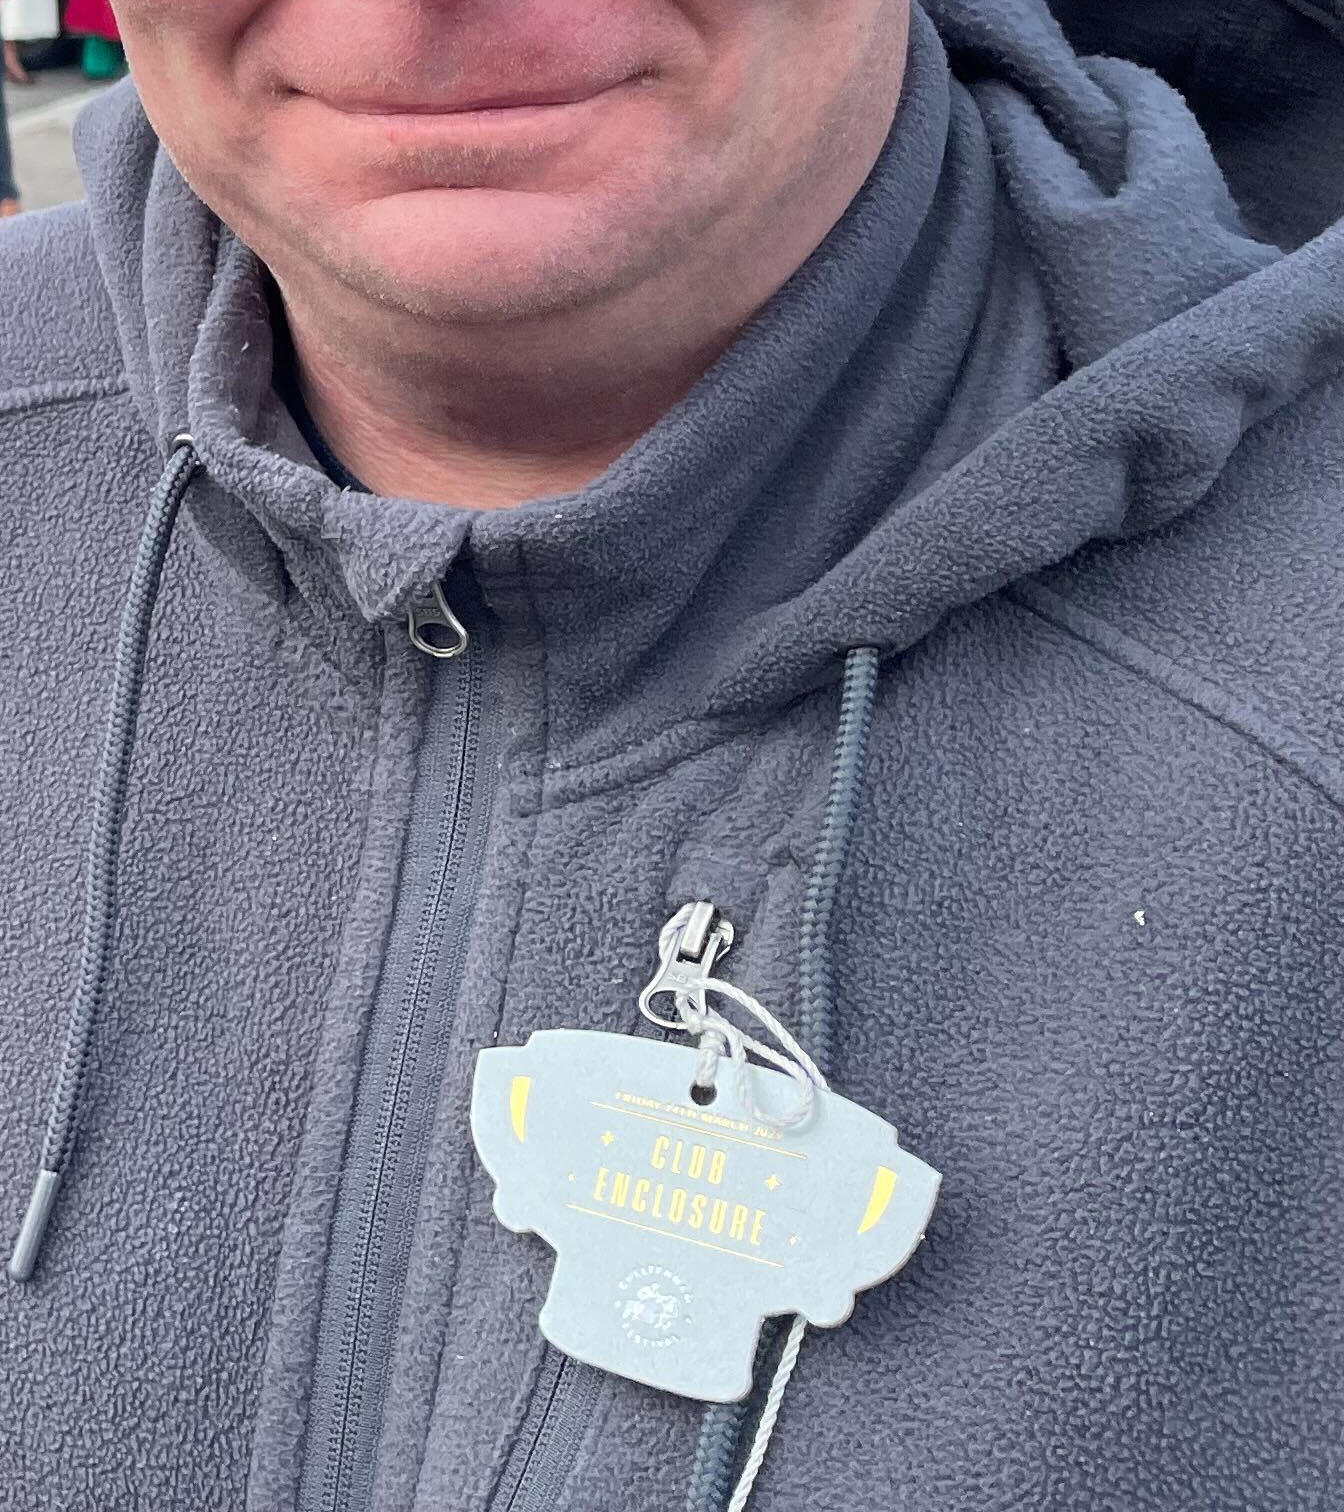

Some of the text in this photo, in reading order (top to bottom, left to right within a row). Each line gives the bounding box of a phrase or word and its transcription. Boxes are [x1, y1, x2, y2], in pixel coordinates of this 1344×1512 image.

[615, 1091, 661, 1110] FRIDAY
[650, 1135, 727, 1185] CLUB
[593, 1167, 767, 1246] ENCLOSURE
